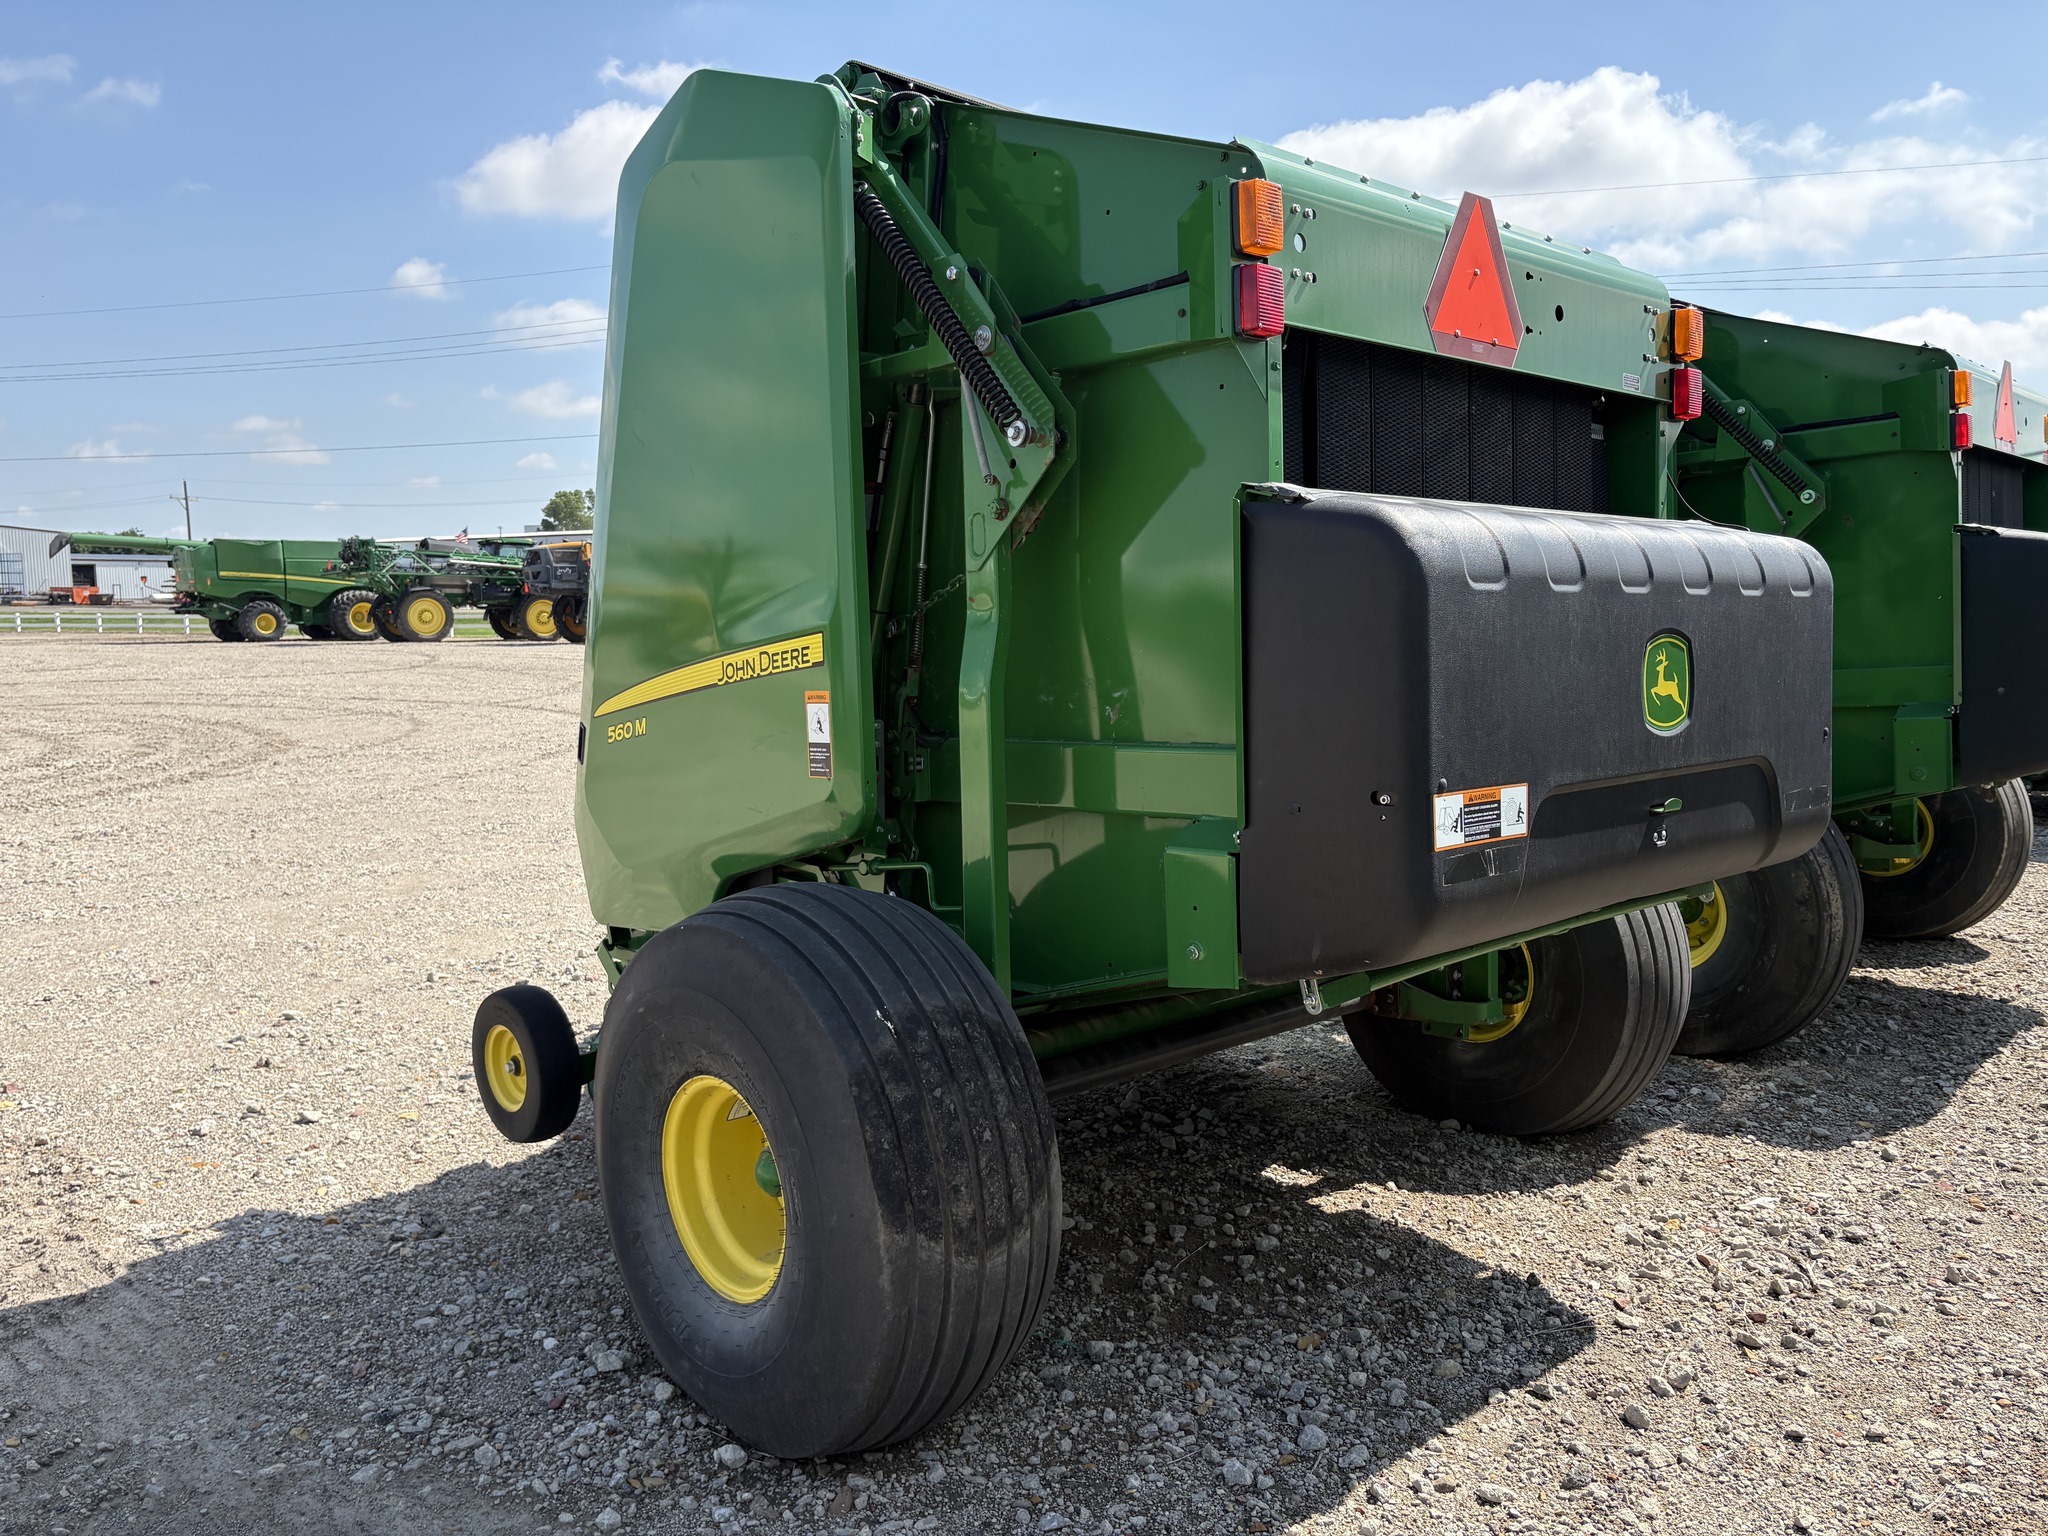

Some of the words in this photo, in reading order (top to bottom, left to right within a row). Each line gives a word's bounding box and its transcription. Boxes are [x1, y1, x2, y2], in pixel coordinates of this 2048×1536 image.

[717, 657, 756, 683] JOHN
[759, 646, 811, 673] DEERE
[607, 720, 633, 744] 560
[635, 716, 647, 737] M
[1473, 792, 1497, 801] WARNING
